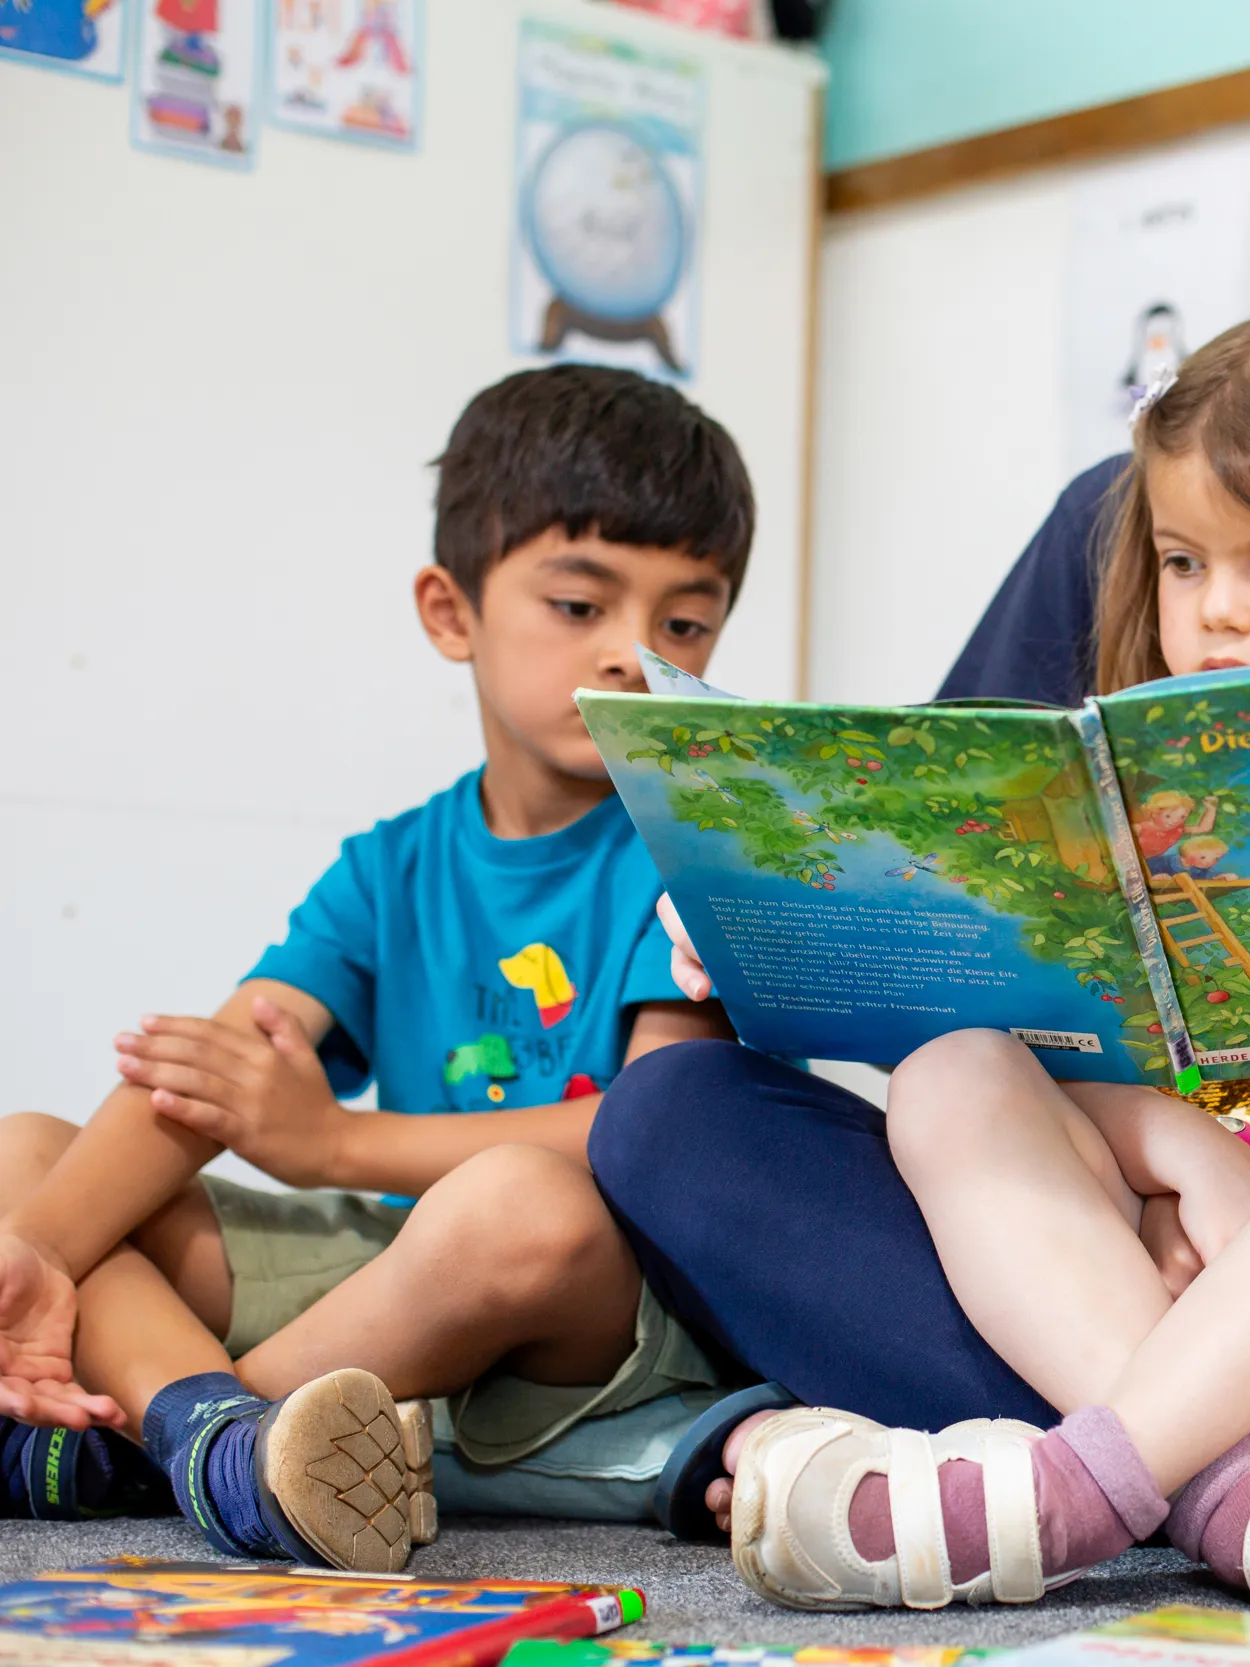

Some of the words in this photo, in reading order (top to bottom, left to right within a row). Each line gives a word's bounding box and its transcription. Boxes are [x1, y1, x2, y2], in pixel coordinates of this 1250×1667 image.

[782, 901, 837, 912] Geburtstag
[859, 906, 911, 916] Baumhaus
[914, 910, 972, 920] bekommen.
[736, 916, 766, 924] Kinder
[770, 919, 805, 928] spielen
[832, 924, 860, 932] oben,
[894, 927, 908, 935] für
[912, 928, 930, 936] Tim
[956, 932, 982, 940] wird,
[748, 926, 777, 934] Hause
[818, 913, 852, 921] Freund
[894, 918, 928, 928] luftige
[932, 921, 990, 932] Behausung.
[748, 944, 787, 953] Terrasse
[790, 946, 837, 958] unzählige
[840, 952, 879, 960] Libellen
[882, 956, 964, 966] umherschwirren.
[754, 936, 804, 945] Abendbrot
[807, 940, 856, 949] bemerken
[858, 944, 892, 952] Hanna
[916, 947, 948, 956] Jonas,
[950, 950, 971, 958] dass
[734, 951, 754, 959] Eine
[758, 954, 804, 963] Botschaft
[854, 960, 908, 971] Tatsächlich
[911, 966, 944, 974] wartet
[965, 969, 996, 978] Kleine
[738, 961, 778, 970] draußen
[828, 968, 890, 979] aufregenden
[948, 976, 966, 984] Tim
[968, 978, 989, 986] sitzt
[993, 980, 1006, 988] im
[742, 970, 793, 980] Baumhaus
[796, 974, 817, 982] fest.
[882, 982, 924, 990] passiert?
[766, 980, 796, 988] Kinder
[800, 984, 851, 993] schmieden
[754, 992, 776, 1000] Eine
[778, 994, 830, 1004] Geschichte
